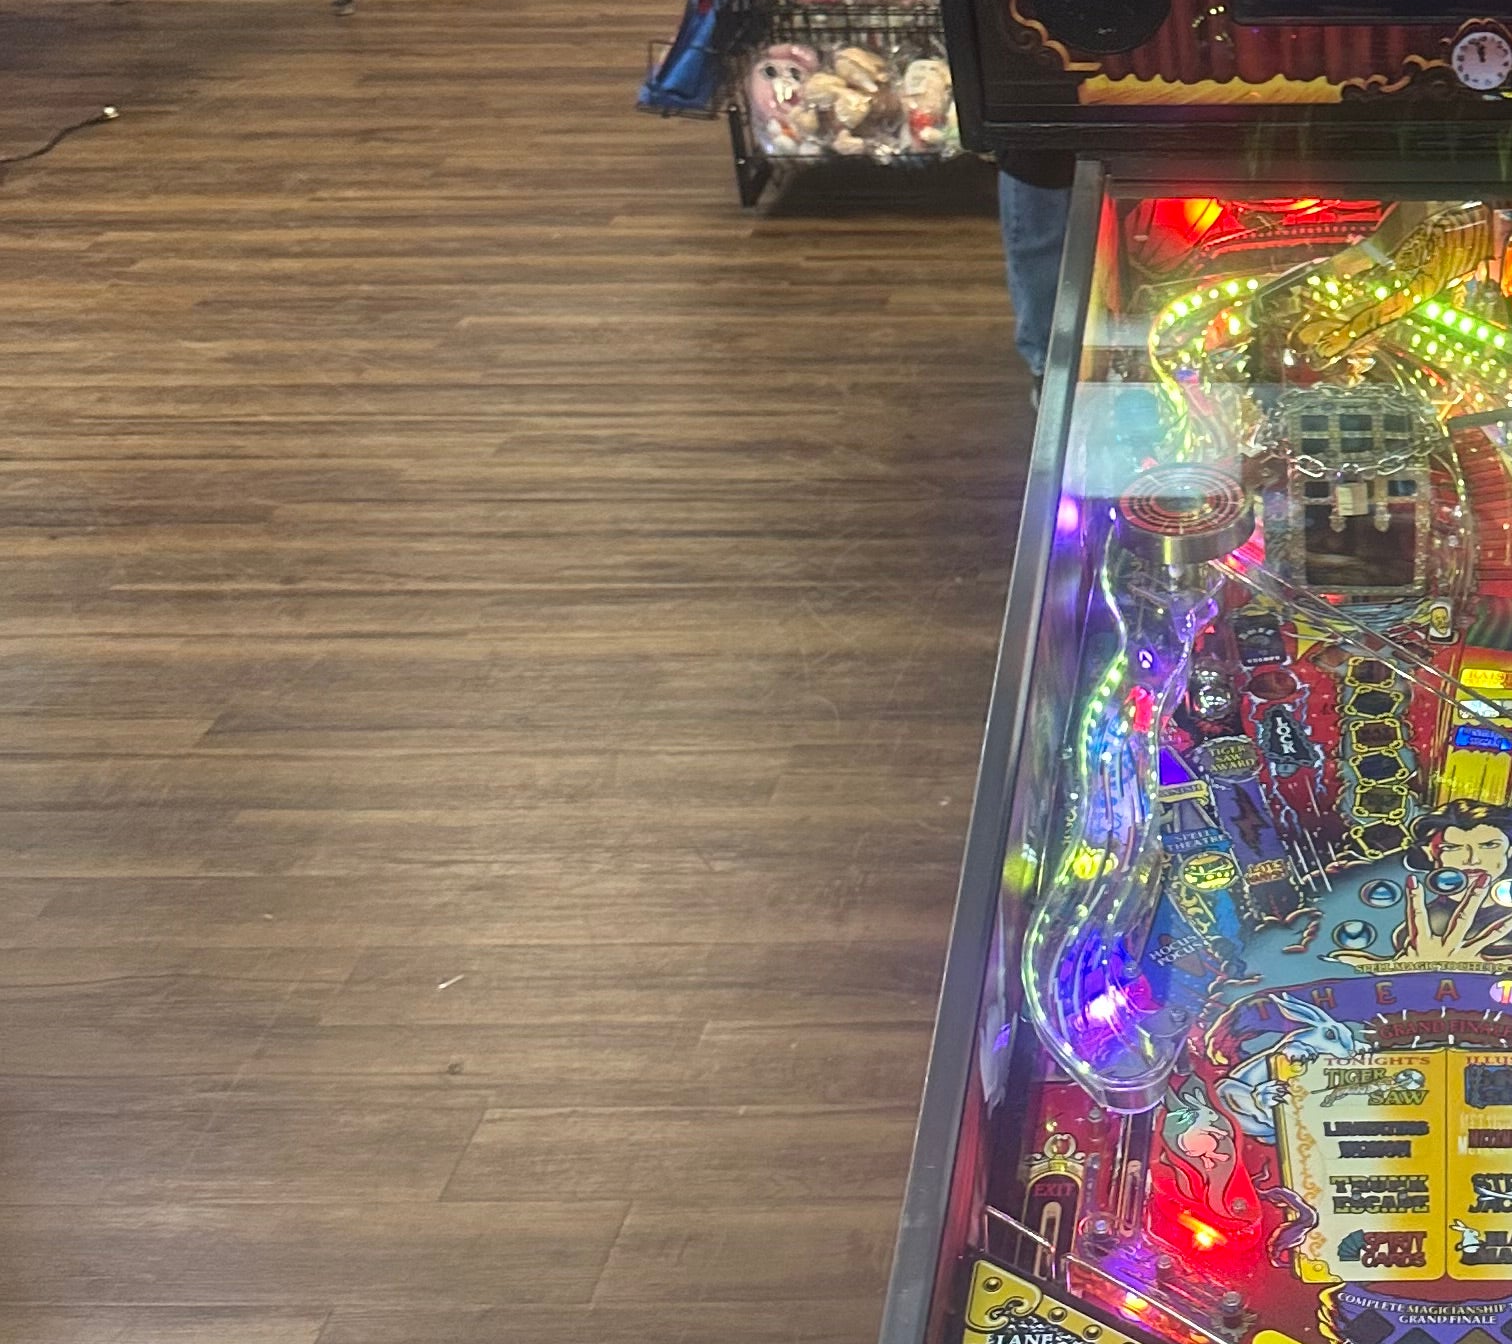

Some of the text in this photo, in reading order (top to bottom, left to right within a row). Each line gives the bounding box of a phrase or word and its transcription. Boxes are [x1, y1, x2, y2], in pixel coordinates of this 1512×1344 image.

[1275, 716, 1298, 755] LOCK
[1209, 758, 1256, 773] AWARD
[1149, 934, 1200, 960] HOCUS
[1157, 941, 1203, 967] POCUS
[1380, 1020, 1446, 1039] GRAND
[1324, 1067, 1386, 1090] TIGER
[1368, 1089, 1430, 1106] SAW
[1031, 1181, 1077, 1199] EXIT
[1337, 1292, 1405, 1313] COMPLETE
[1406, 1303, 1507, 1315] MAGICIANSHIP
[1398, 1314, 1498, 1325] GRAND FINALE
